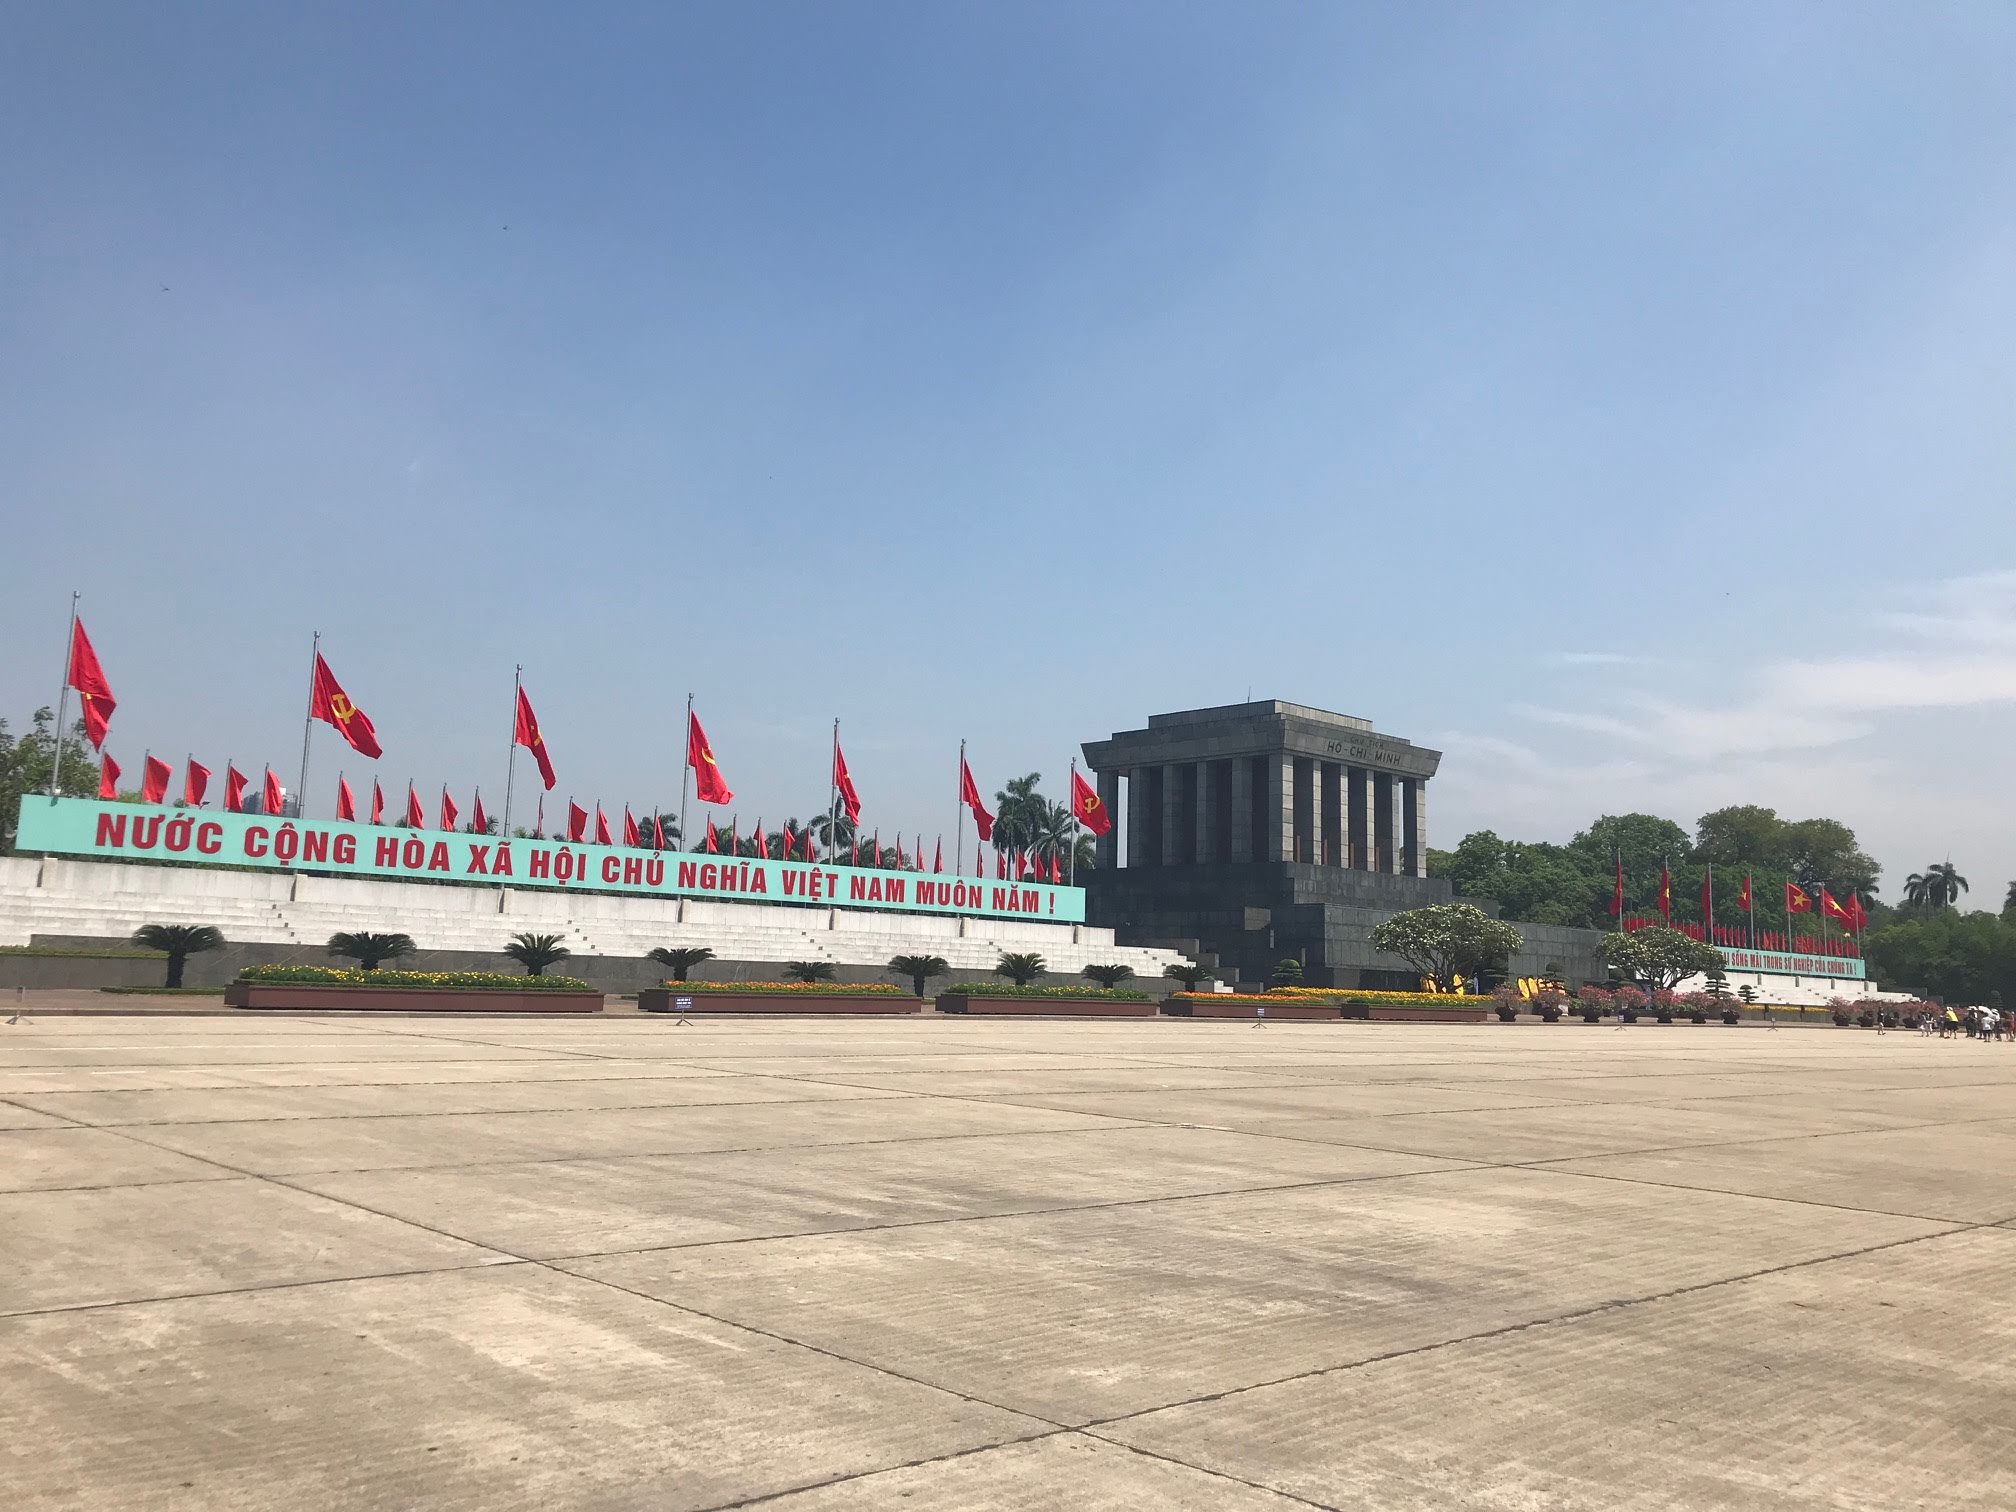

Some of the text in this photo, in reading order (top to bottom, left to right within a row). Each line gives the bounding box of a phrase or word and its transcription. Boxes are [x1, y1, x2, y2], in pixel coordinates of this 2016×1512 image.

[1374, 751, 1401, 766] MINH
[95, 812, 1055, 915] NƯỚC CỘNG HÒA XÃ HỘI CHỦ NGHĨA VIỆT NAM MUÔN NĂM !
[1763, 954, 1783, 970] TRONG
